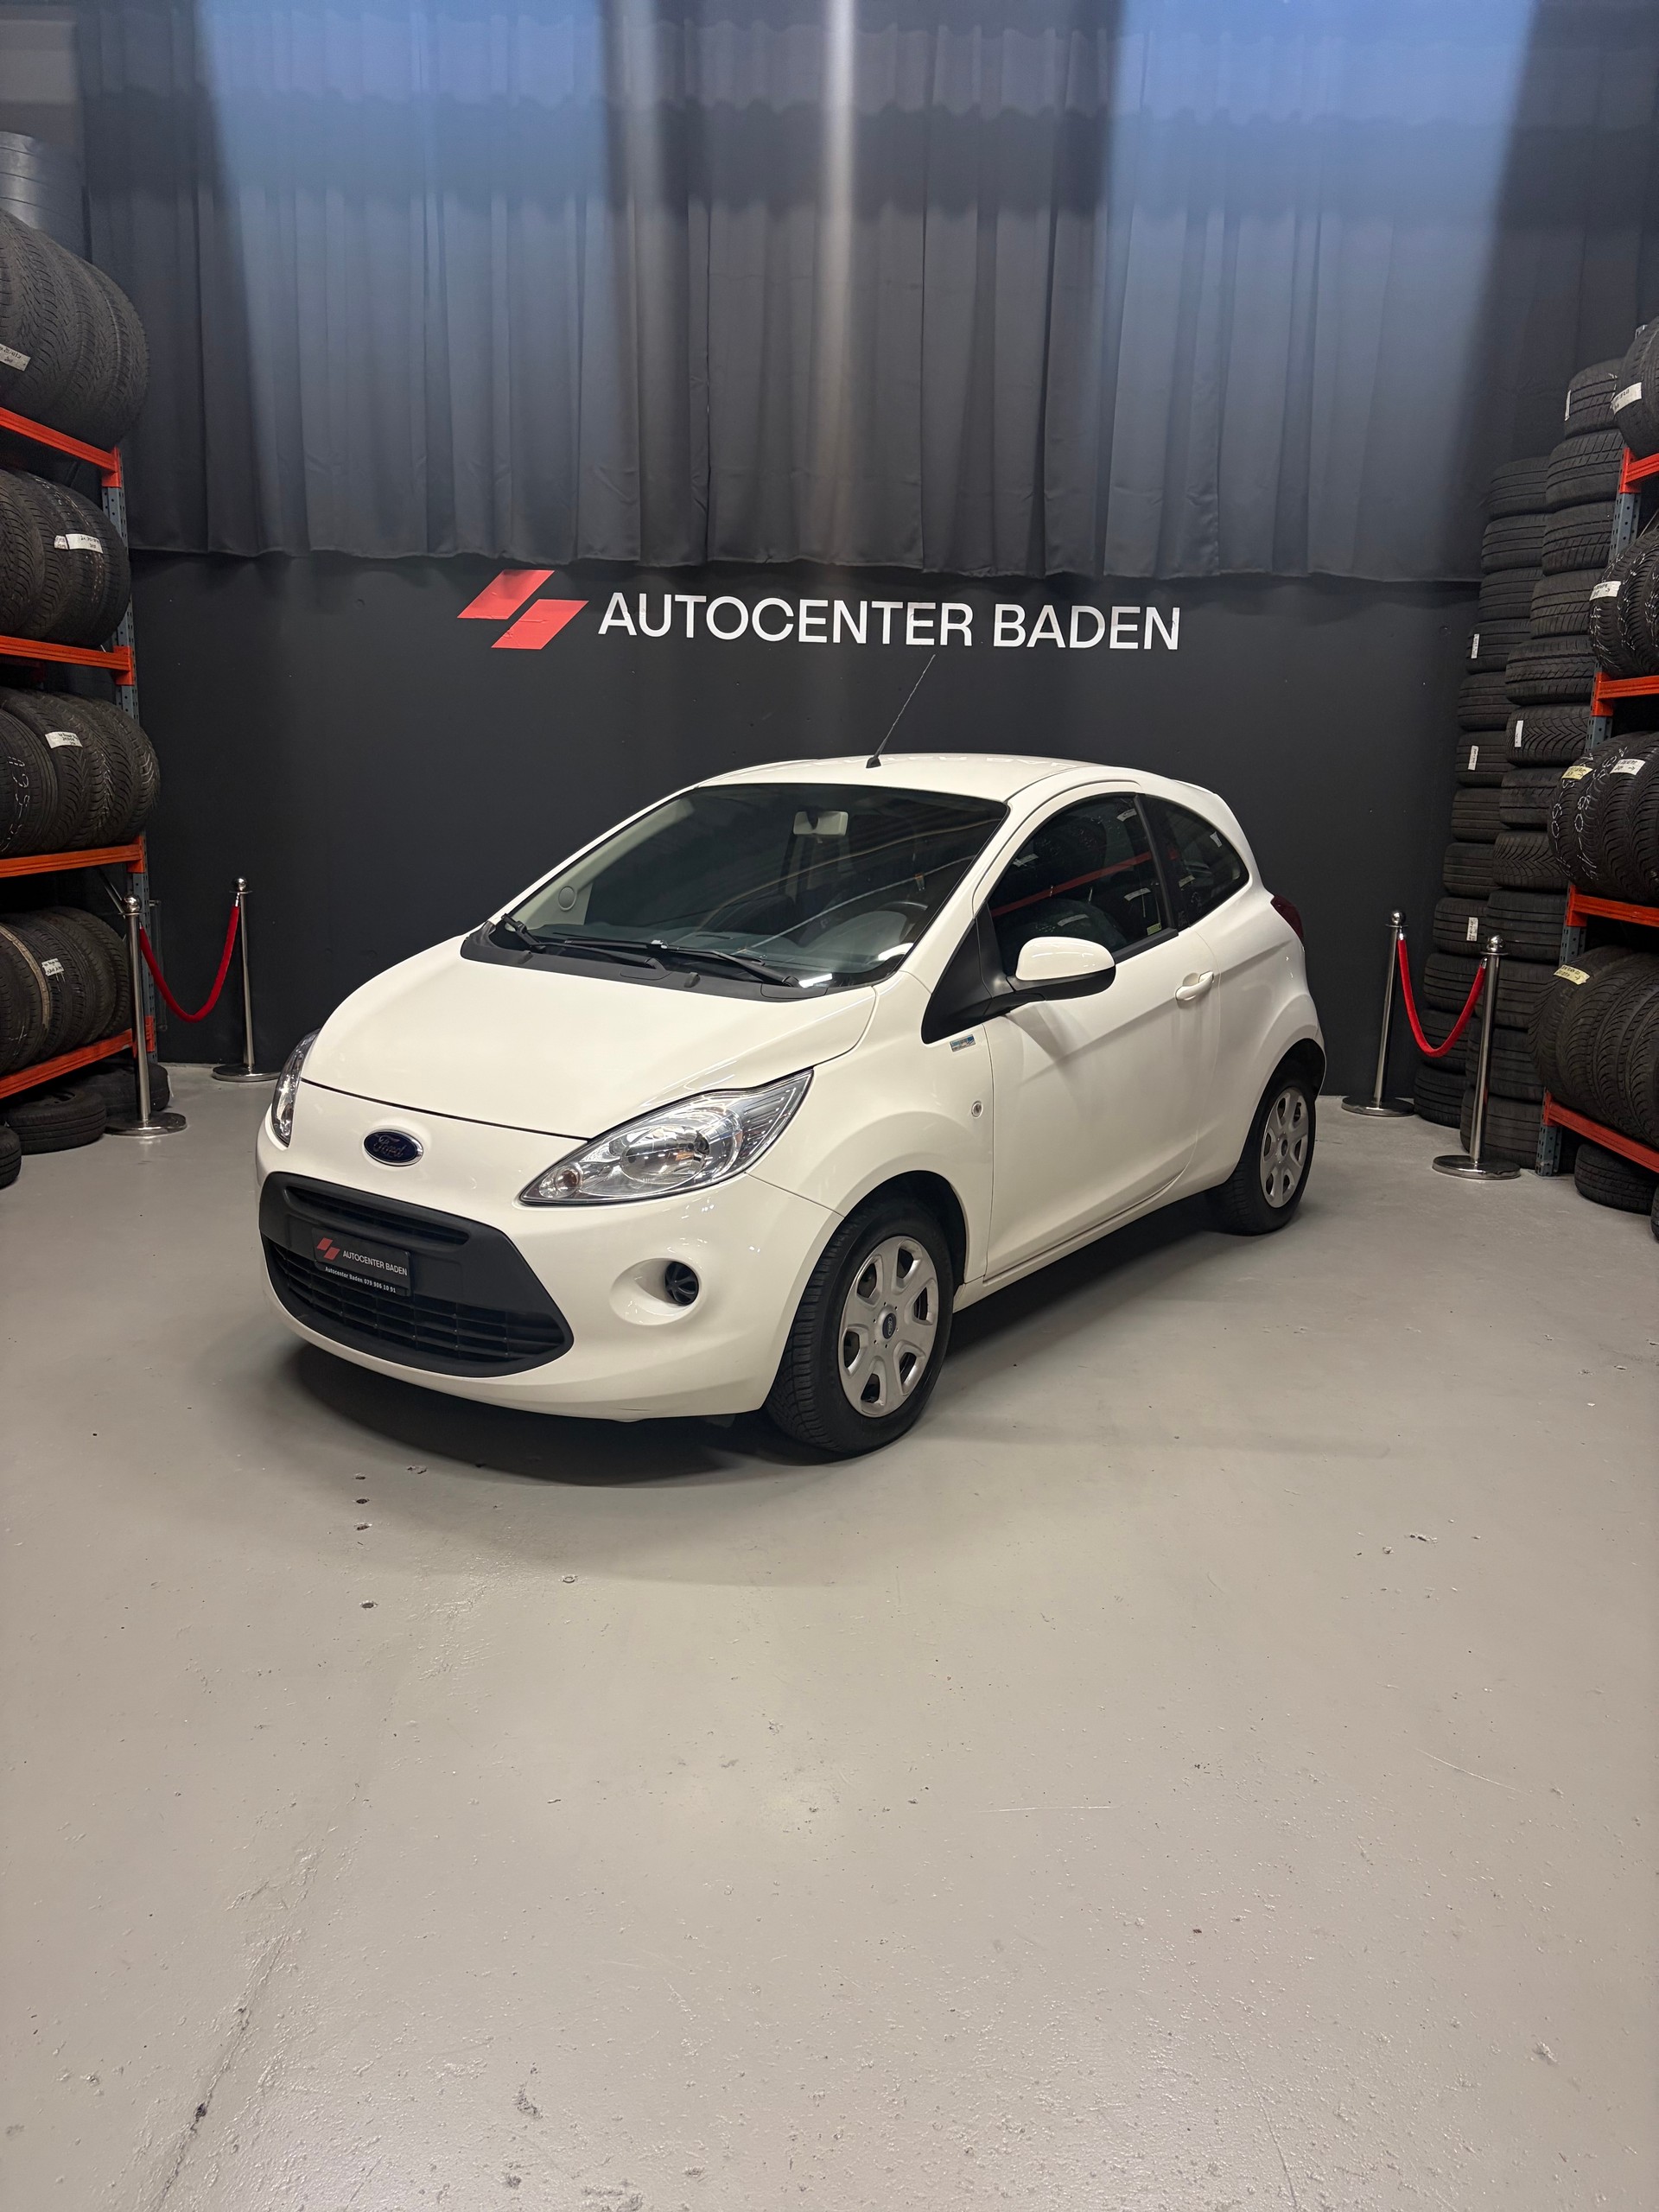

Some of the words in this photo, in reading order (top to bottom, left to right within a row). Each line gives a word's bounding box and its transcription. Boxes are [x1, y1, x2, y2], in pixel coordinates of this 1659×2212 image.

[598, 592, 974, 646] AUTOCENTER
[993, 603, 1180, 651] BADEN
[373, 1135, 407, 1158] Ford
[325, 1266, 348, 1278] Autocenter
[349, 1274, 363, 1283] Baden
[343, 1250, 385, 1269] AUTOCENTER
[385, 1262, 408, 1276] BADEN
